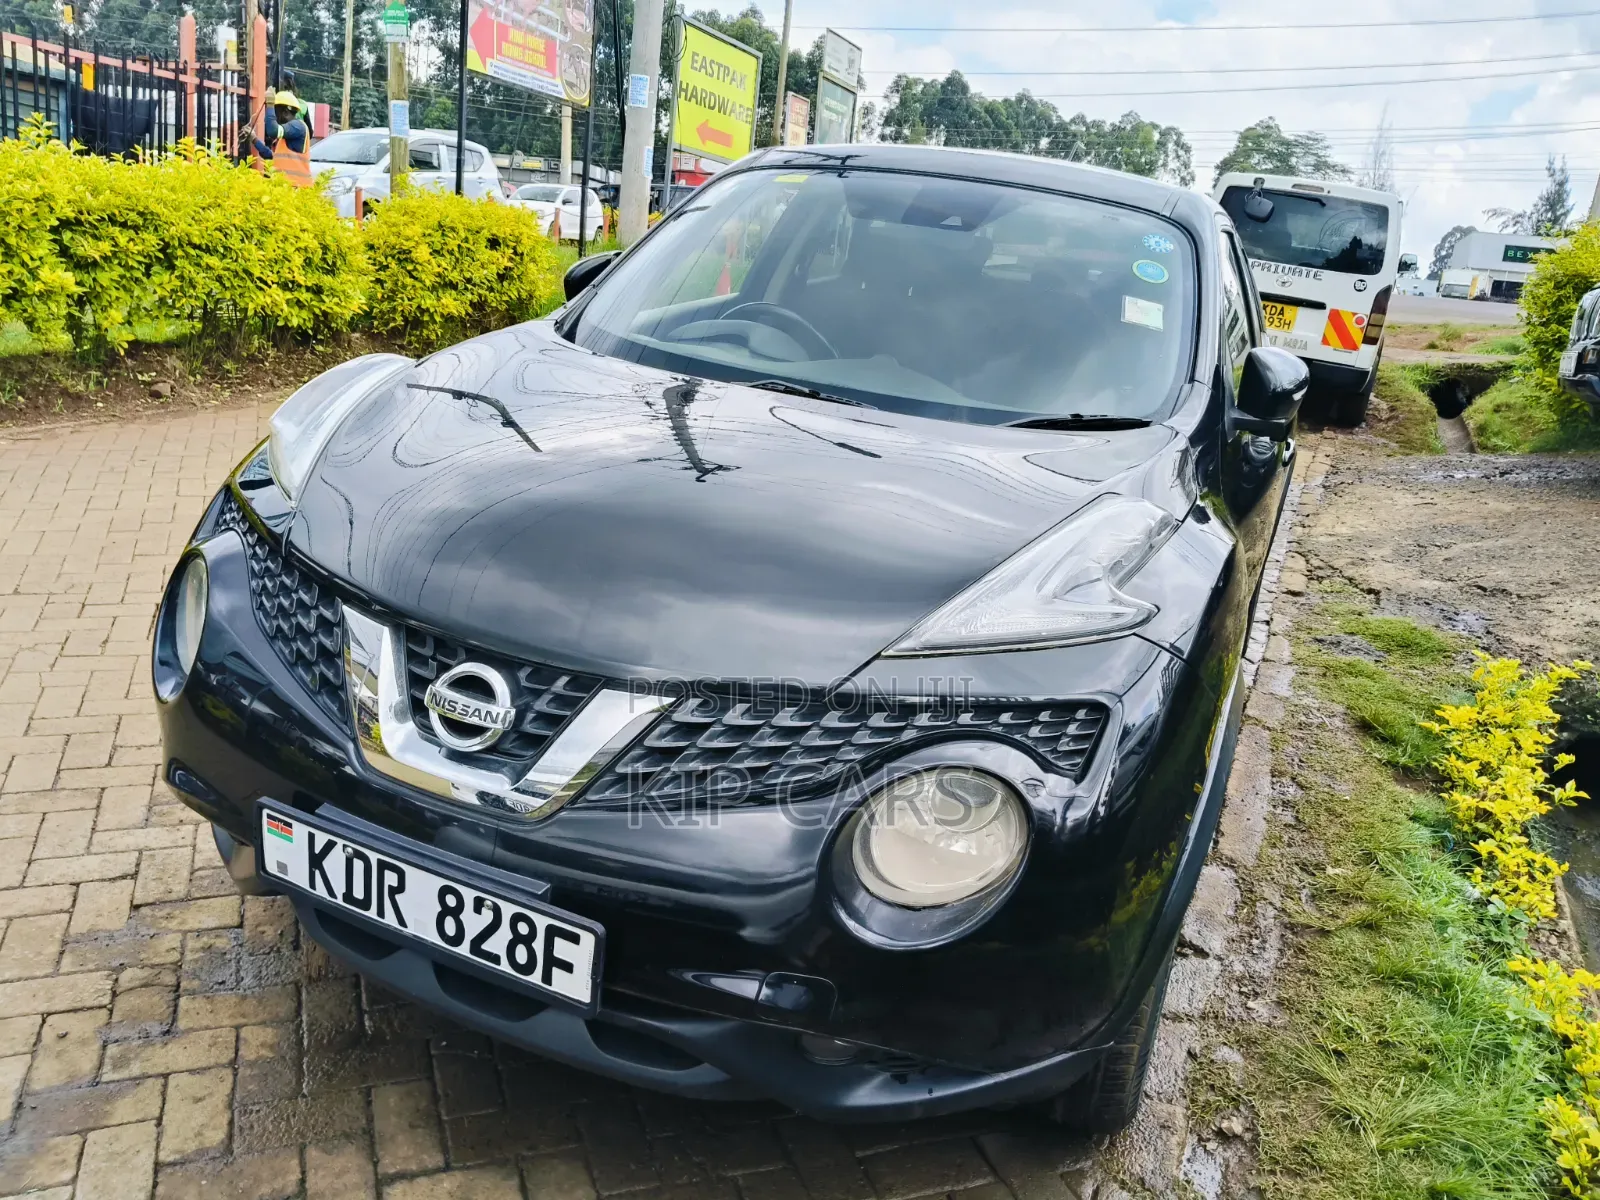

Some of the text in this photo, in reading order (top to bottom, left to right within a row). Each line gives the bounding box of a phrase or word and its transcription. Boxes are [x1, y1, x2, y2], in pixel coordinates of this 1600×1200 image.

[679, 80, 753, 125] HARDWARE
[1262, 303, 1285, 317] KDA
[1264, 316, 1292, 330] 93H
[430, 691, 501, 725] NISSAN
[307, 831, 408, 928] KDR
[435, 884, 581, 986] 828F
